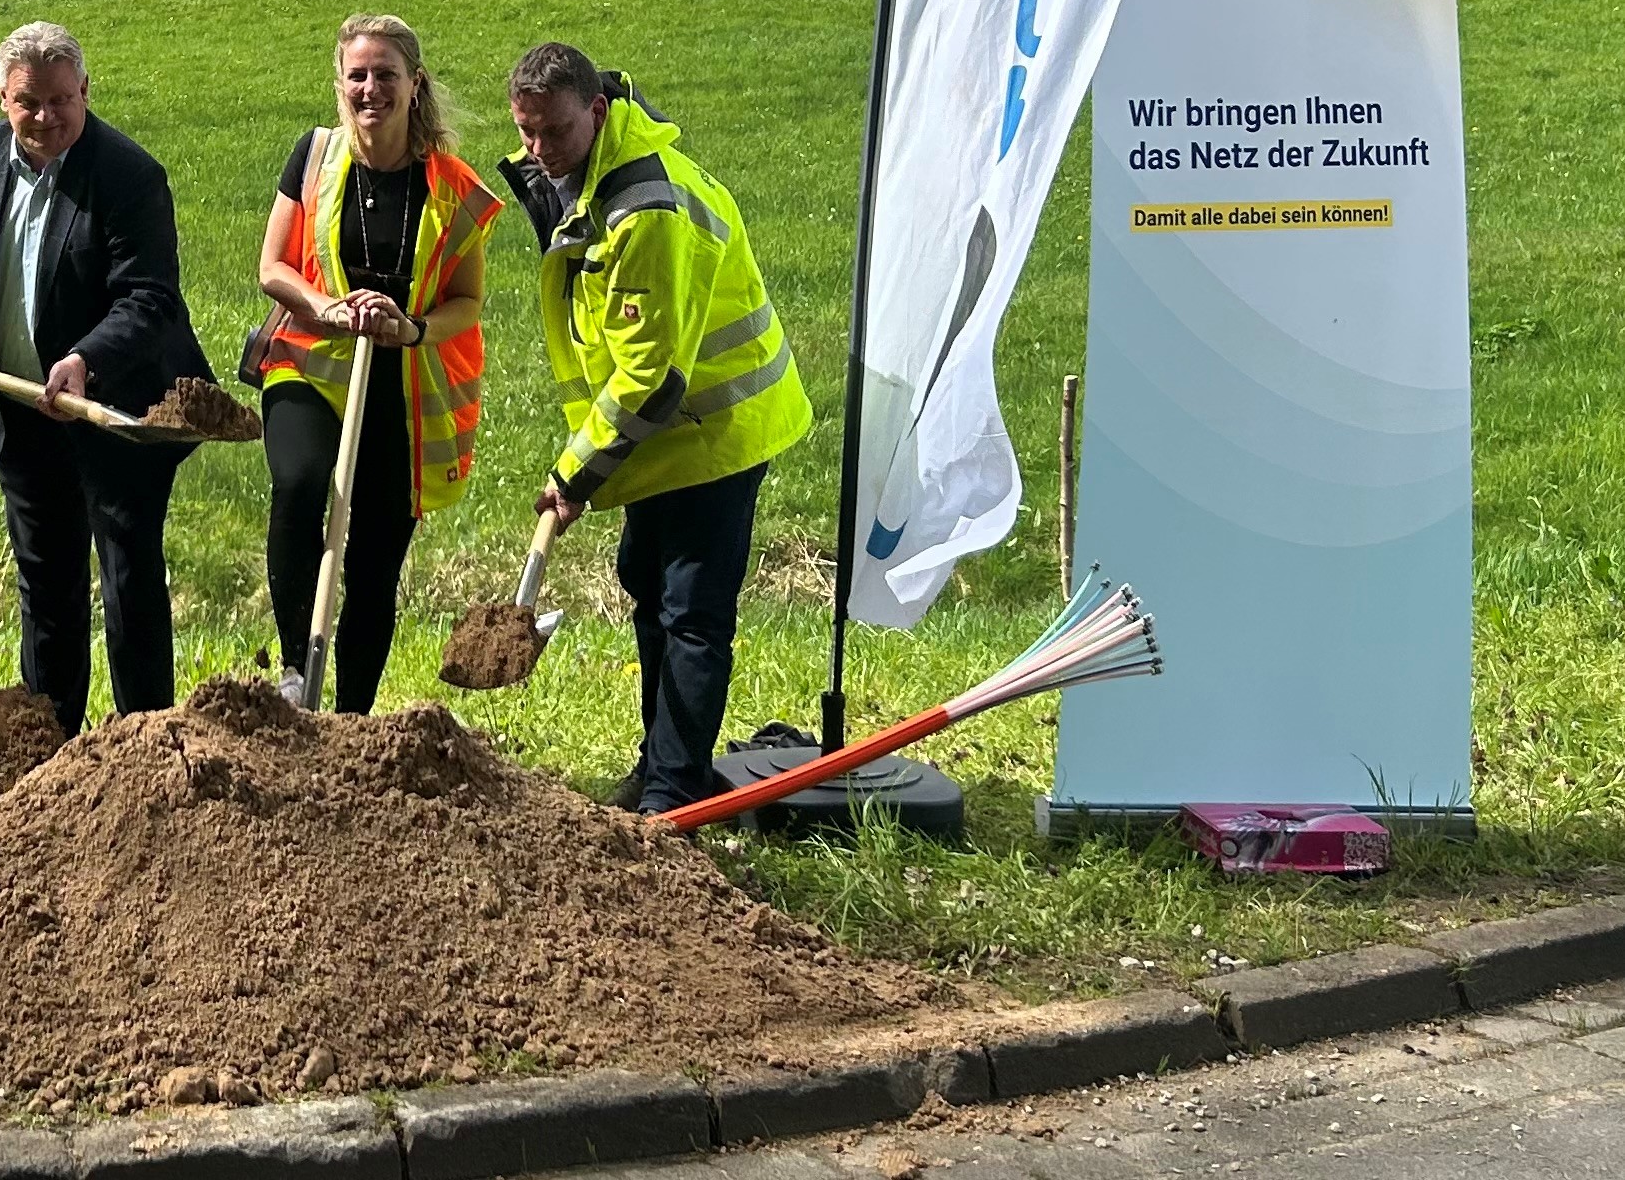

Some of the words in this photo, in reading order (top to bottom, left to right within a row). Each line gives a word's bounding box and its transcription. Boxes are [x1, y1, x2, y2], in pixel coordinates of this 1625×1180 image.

[1128, 98, 1177, 127] Wir
[1185, 97, 1297, 133] bringen
[1305, 95, 1383, 125] Ihnen
[1129, 140, 1181, 170] das
[1190, 141, 1259, 170] Netz
[1267, 138, 1315, 168] der
[1321, 137, 1430, 167] Zukunft
[1133, 208, 1187, 227] Damit
[1191, 207, 1224, 226] alle
[1228, 206, 1277, 225] dabei
[1280, 205, 1317, 224] sein
[1321, 204, 1389, 223] können!
